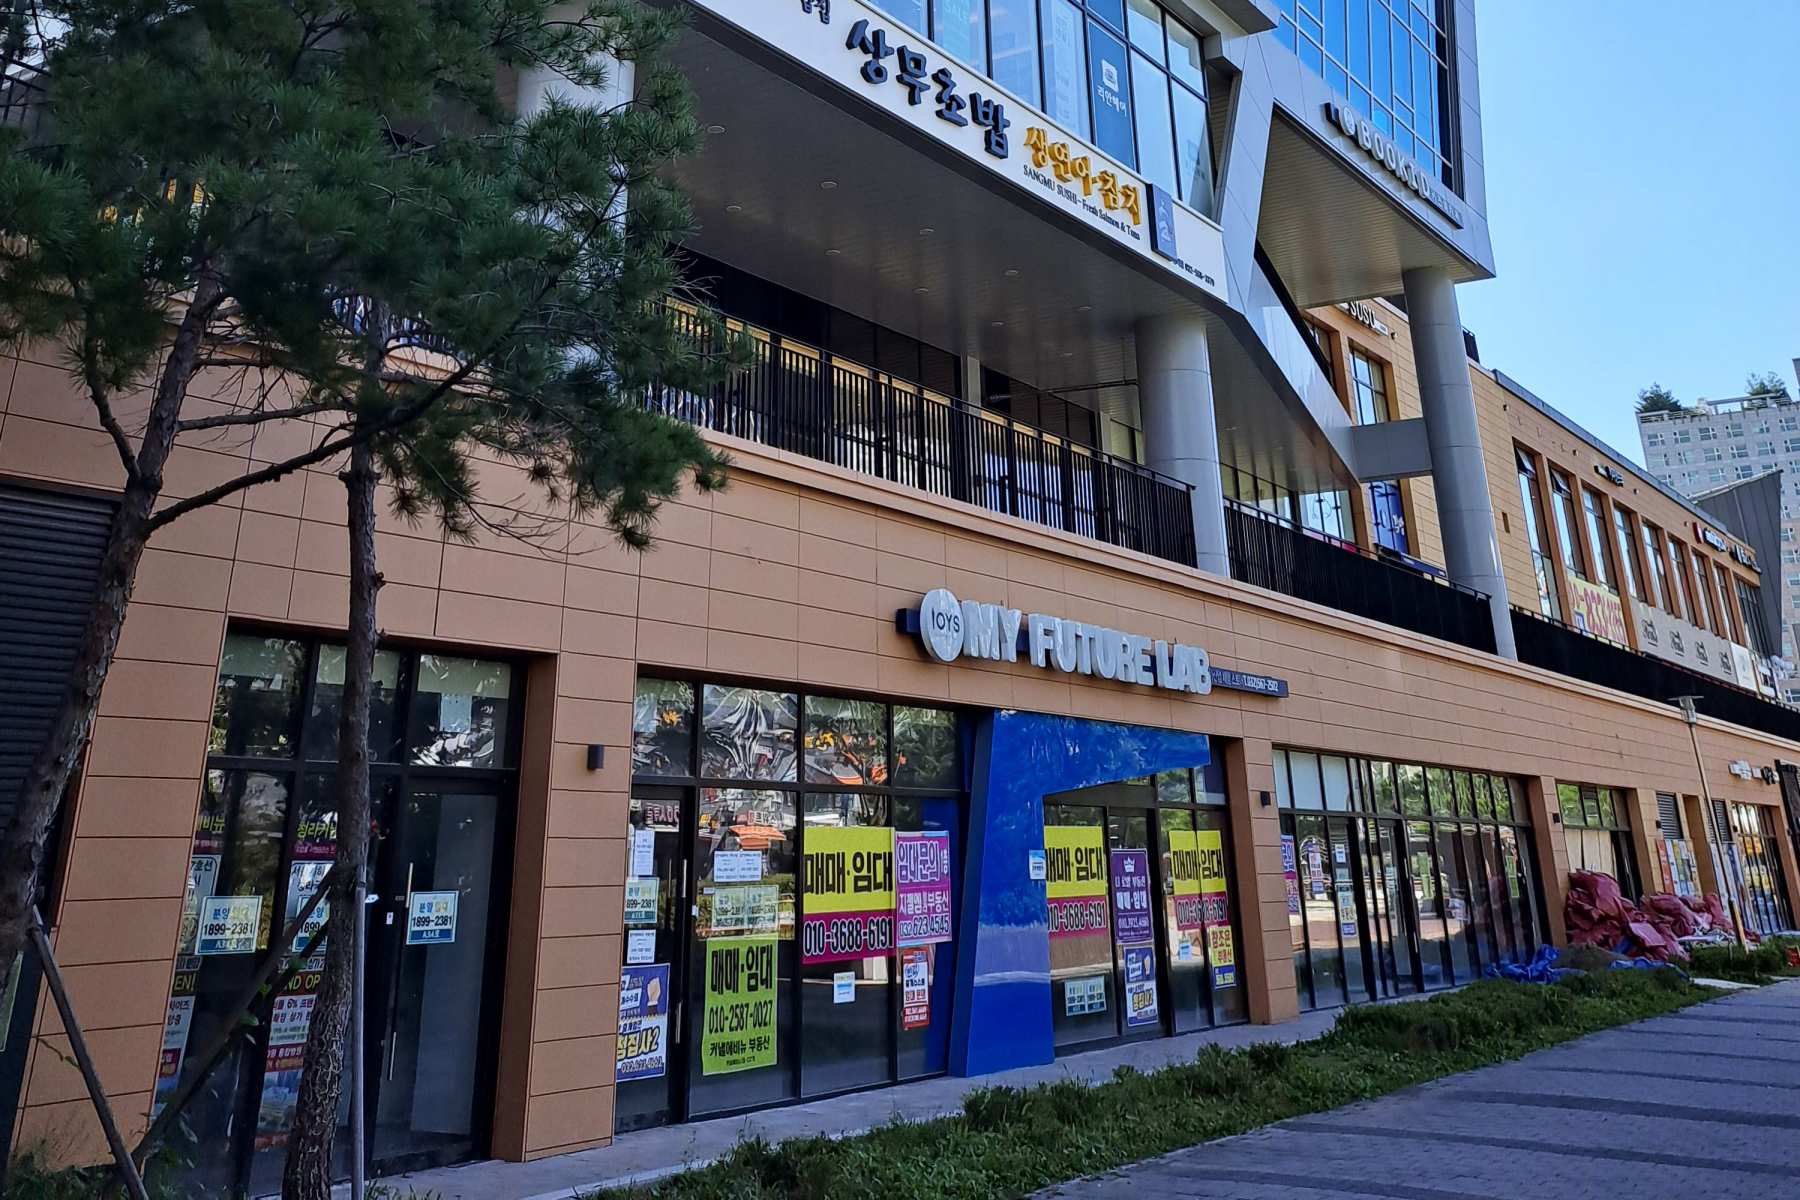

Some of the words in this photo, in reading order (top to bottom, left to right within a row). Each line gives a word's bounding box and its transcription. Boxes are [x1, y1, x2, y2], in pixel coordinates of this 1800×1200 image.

[845, 17, 1011, 160] 상무초밥
[1023, 164, 1056, 192] SANGMU
[961, 599, 1022, 663] MY
[1028, 612, 1156, 687] FUTURE
[1155, 639, 1213, 696] LAB
[803, 851, 893, 895] 매매·임대
[897, 840, 940, 883] 임대문의
[203, 922, 254, 937] 1899-2381
[412, 915, 453, 928] 1899-2381
[1176, 896, 1228, 926] 010-368-6191
[803, 916, 895, 956] 010-3688-6191
[710, 943, 774, 996] 매매·임대
[708, 999, 774, 1035] 010-2587-0027
[748, 1035, 771, 1053] 부동산
